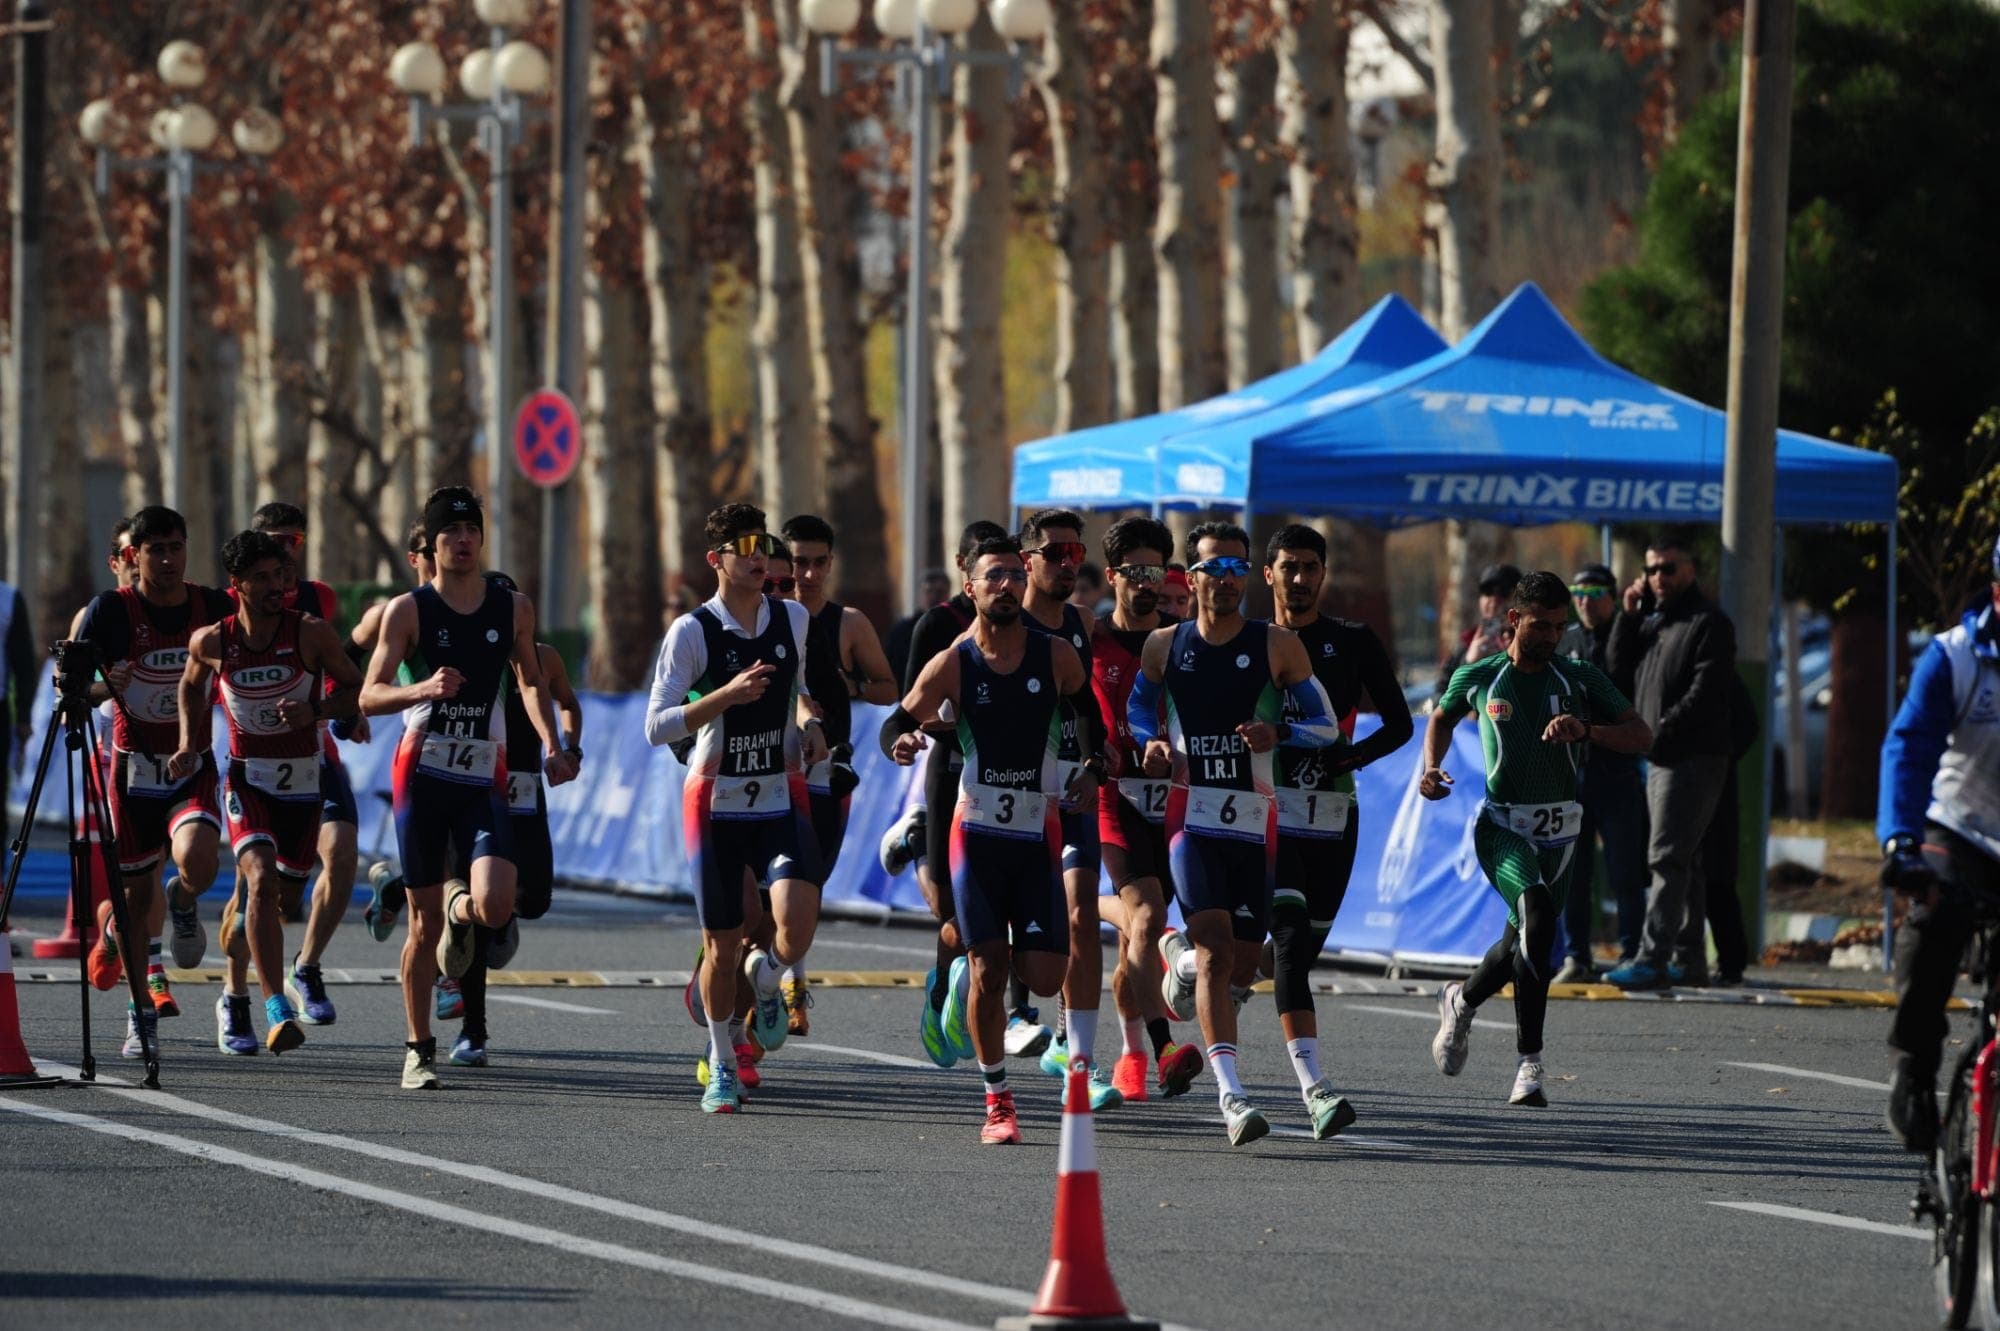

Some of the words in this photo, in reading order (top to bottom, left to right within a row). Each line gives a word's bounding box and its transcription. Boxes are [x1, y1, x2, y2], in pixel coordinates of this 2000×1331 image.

[1409, 390, 1676, 419] TRINX
[1405, 472, 1579, 507] TRINX
[1585, 478, 1724, 512] BIKES
[240, 667, 283, 683] IRQ
[438, 702, 487, 720] Aghaei
[1487, 704, 1508, 715] SUFI
[444, 721, 475, 738] IR.I
[729, 728, 781, 753] EBRAHIMI
[446, 742, 474, 771] 14
[1190, 734, 1245, 756] REZAEI
[735, 747, 771, 773] I.R.I
[1203, 758, 1238, 780] I.R.I
[276, 763, 294, 791] 2
[984, 768, 1037, 785] Gholipoor
[743, 780, 760, 808] 9
[1143, 784, 1169, 812] 12
[995, 793, 1015, 824] 3
[1219, 795, 1238, 825] 6
[1307, 795, 1317, 825] 1
[1532, 807, 1564, 837] 25
